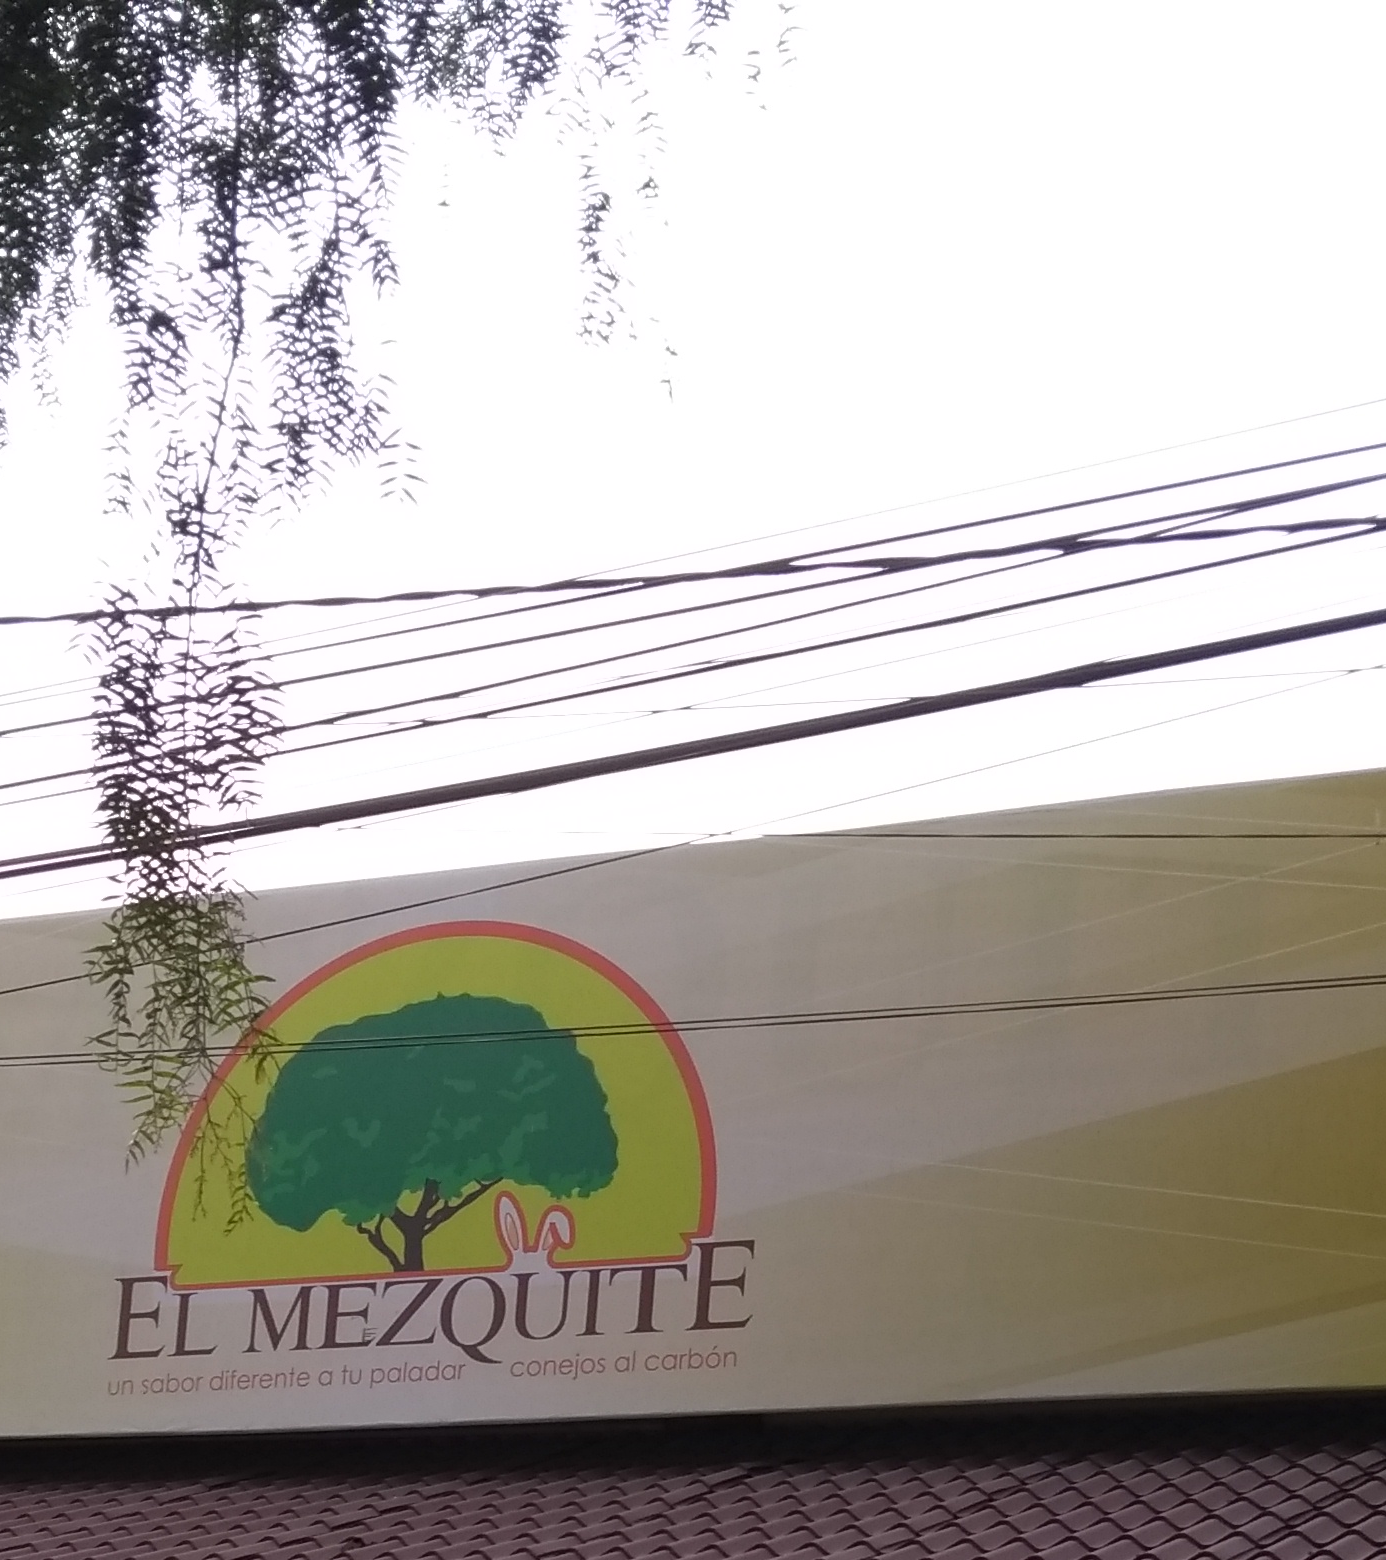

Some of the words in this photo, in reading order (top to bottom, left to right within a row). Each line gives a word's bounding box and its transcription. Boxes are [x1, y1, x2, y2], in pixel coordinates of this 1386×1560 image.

[107, 1275, 218, 1360] EL
[242, 1239, 755, 1364] MEZQUITE
[107, 1378, 134, 1396] un
[142, 1372, 203, 1395] sabor
[209, 1367, 311, 1392] diferente
[318, 1367, 334, 1387] a
[341, 1364, 362, 1386] tu
[370, 1359, 467, 1389] paladar
[509, 1353, 607, 1380] conejos
[614, 1350, 637, 1374] al
[644, 1345, 738, 1372] carbón
